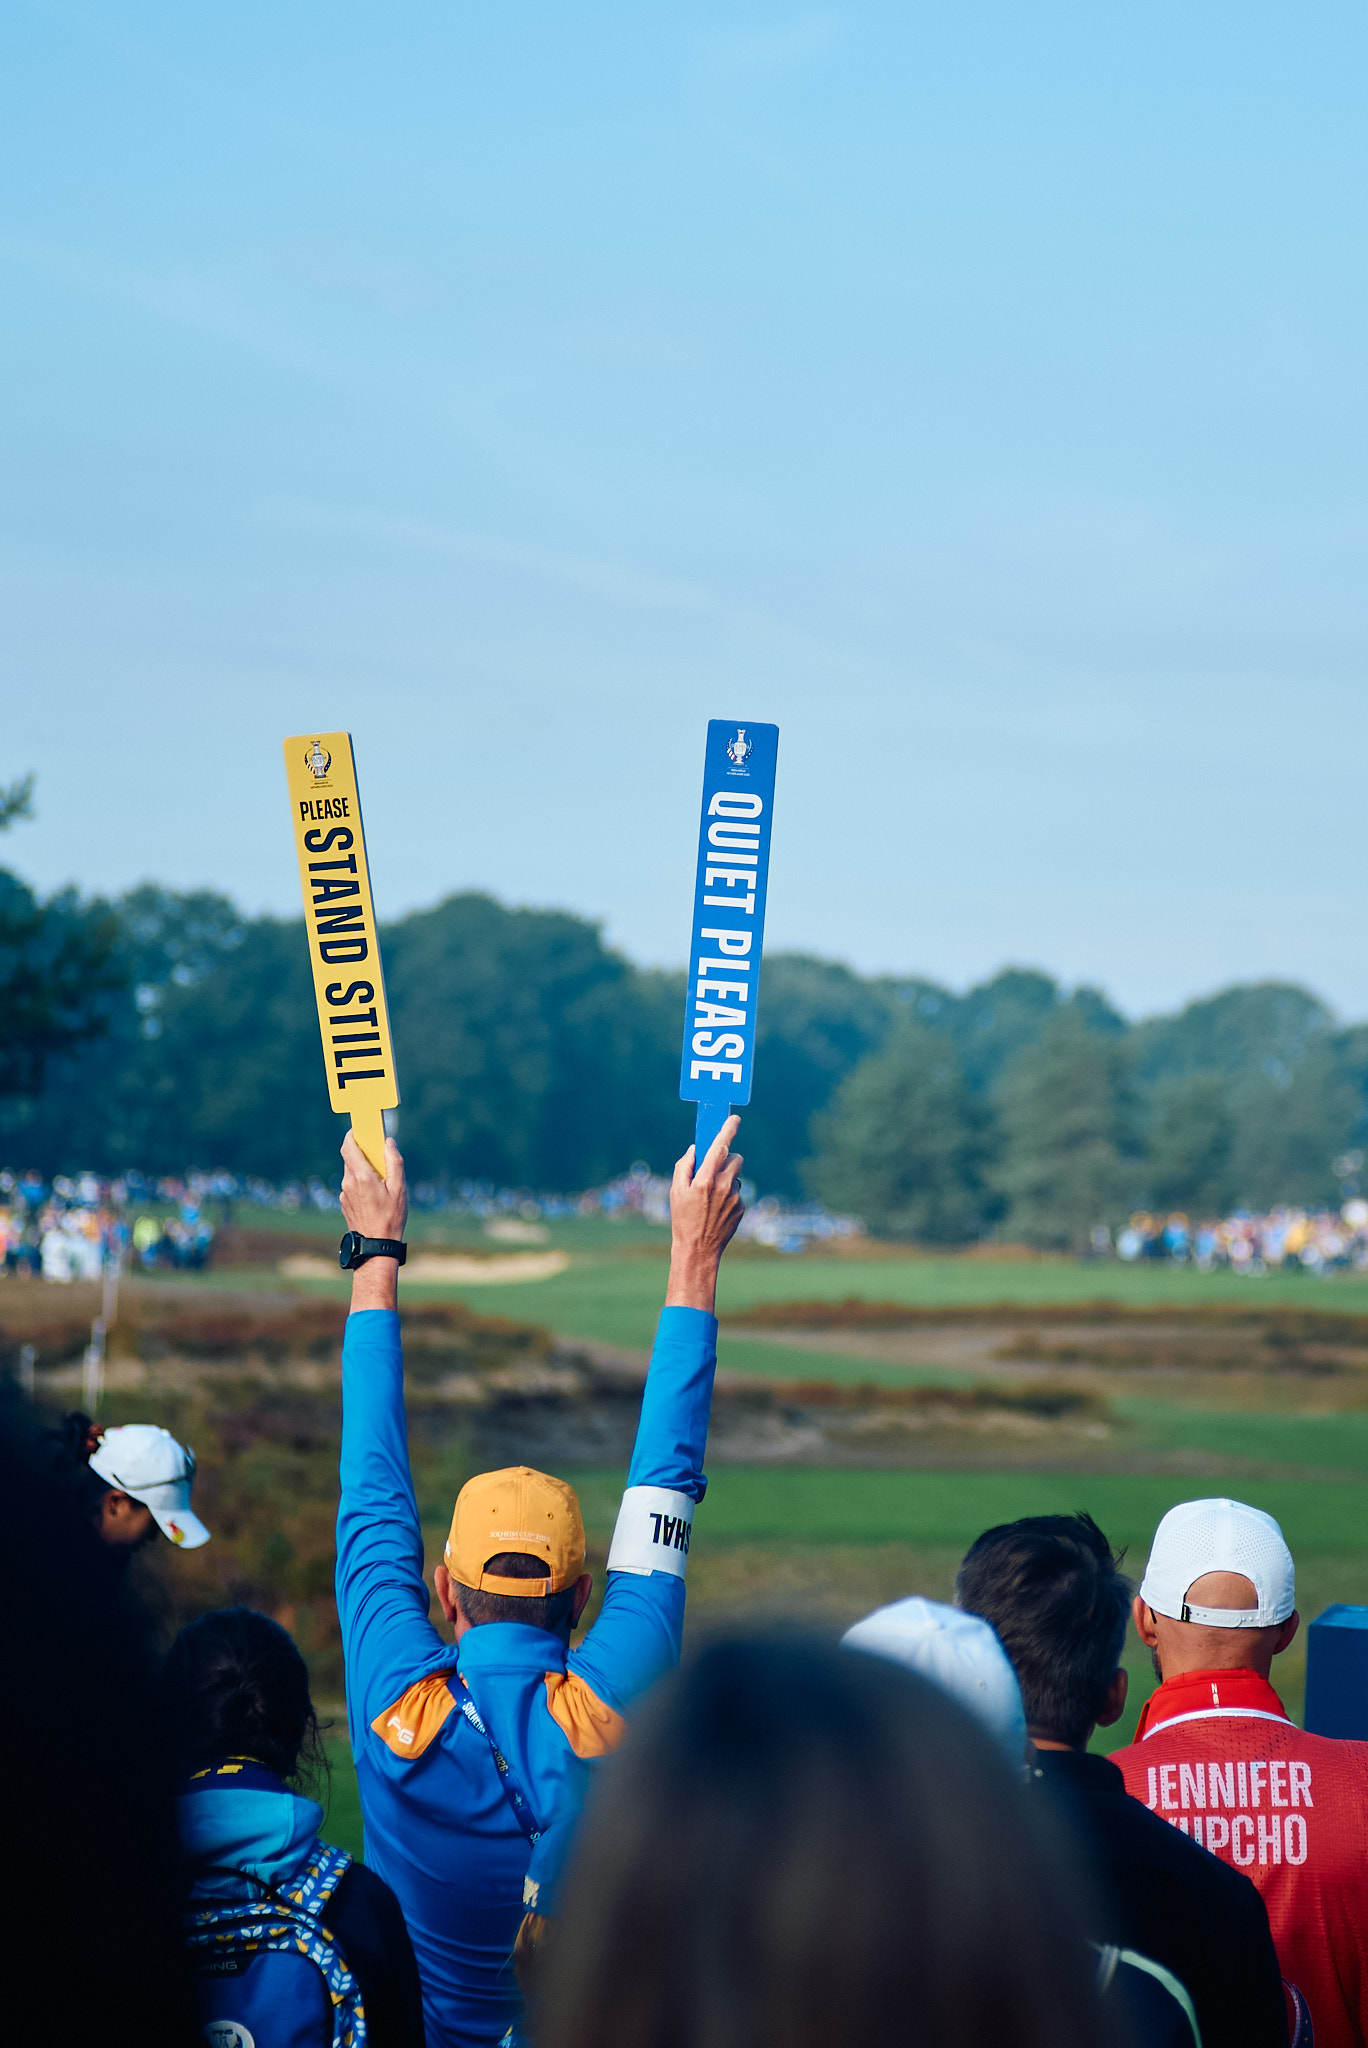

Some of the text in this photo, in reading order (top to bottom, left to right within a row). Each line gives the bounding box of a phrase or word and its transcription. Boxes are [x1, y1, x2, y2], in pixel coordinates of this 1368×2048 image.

[300, 797, 350, 821] PLEASE
[702, 791, 763, 915] QUIET
[303, 826, 386, 1090] STAND STILL
[690, 928, 753, 1083] PLEASE
[462, 1701, 509, 1772] SOLHEIM 2026
[1145, 1761, 1314, 1811] JENNIFER
[1168, 1814, 1308, 1866] PCHO
[202, 1961, 238, 1971] ING
